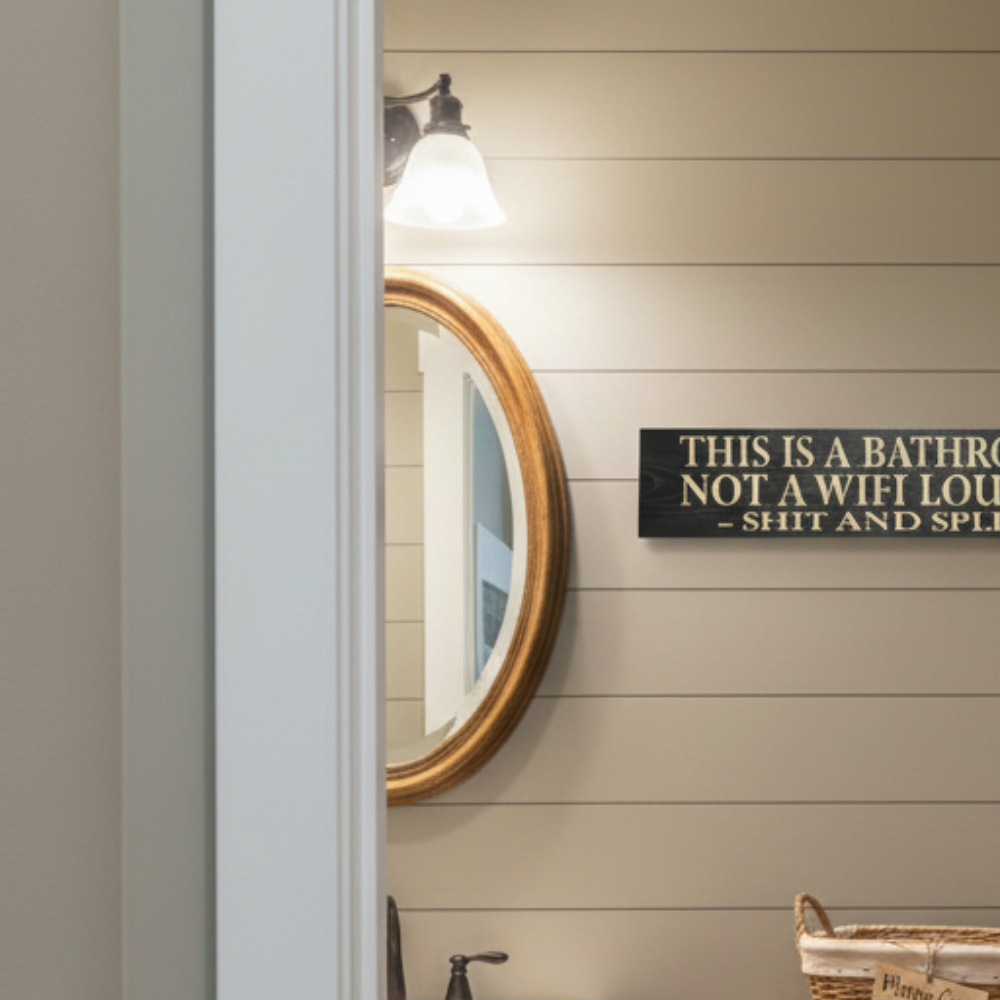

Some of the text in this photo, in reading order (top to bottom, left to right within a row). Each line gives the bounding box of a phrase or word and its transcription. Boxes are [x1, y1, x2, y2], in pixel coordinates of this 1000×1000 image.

[679, 435, 771, 468] THIS
[782, 435, 815, 468] IS
[823, 435, 851, 468] A
[680, 473, 769, 507] NOT
[777, 473, 807, 507] A
[813, 473, 909, 507] WIFI
[742, 511, 829, 532] SHIT
[836, 511, 922, 532] AND
